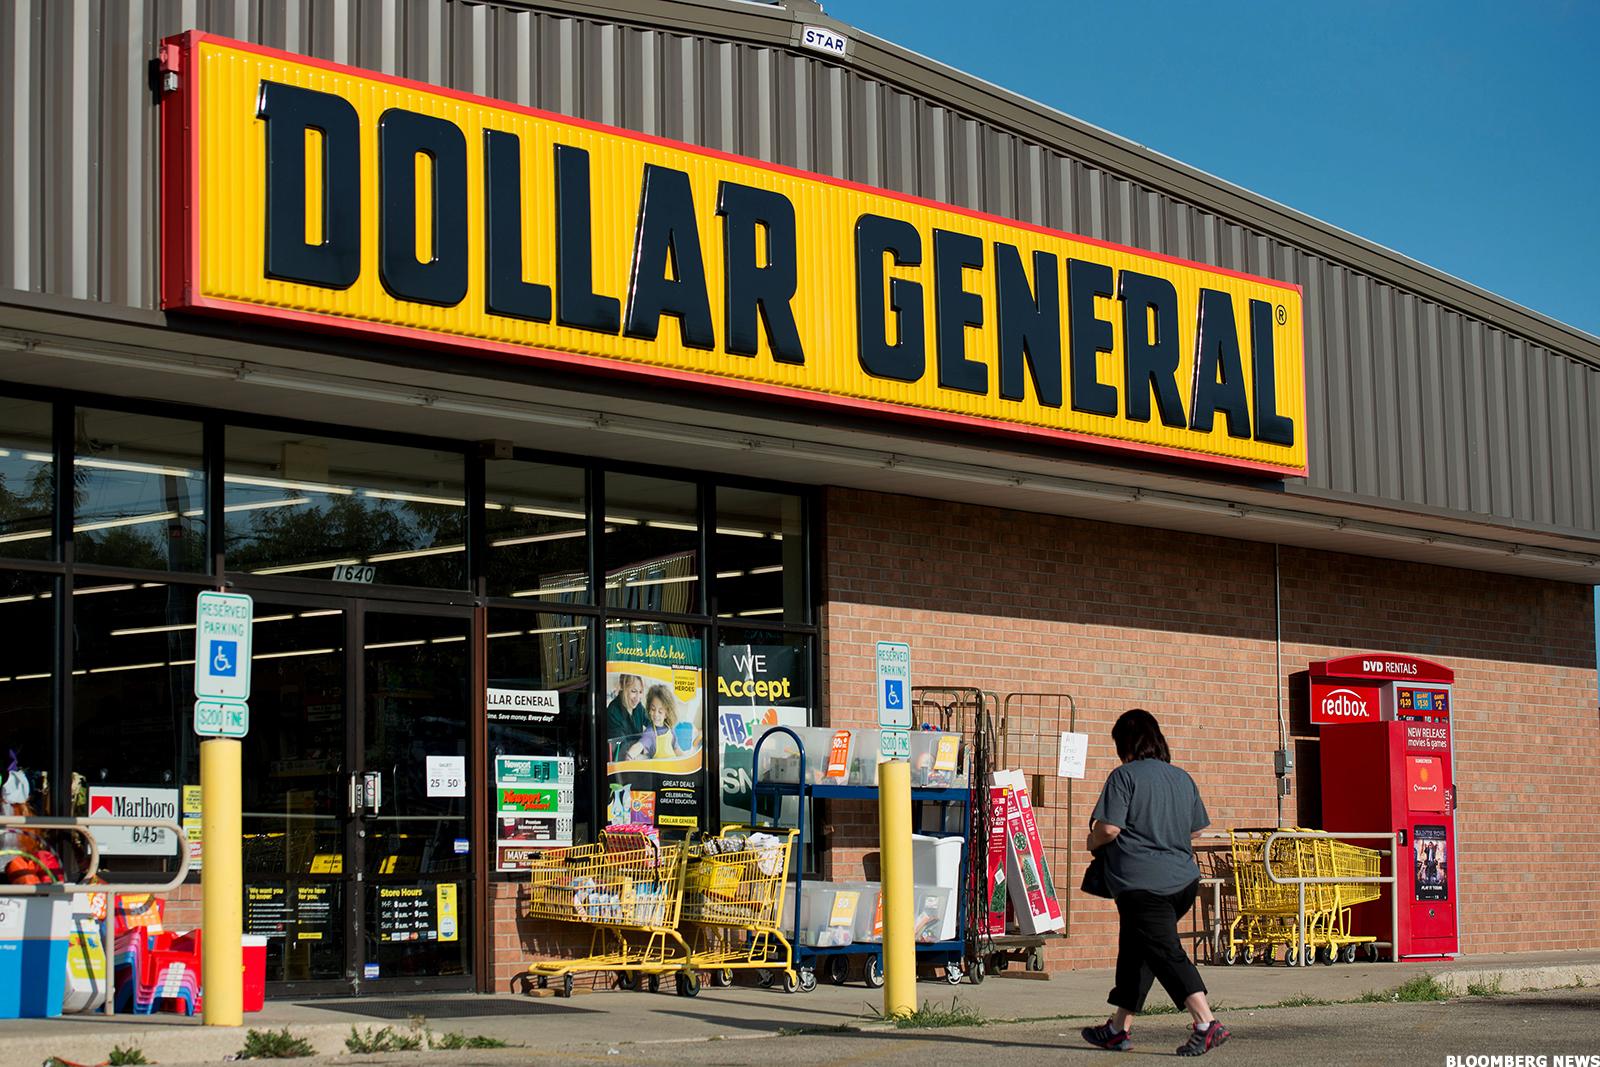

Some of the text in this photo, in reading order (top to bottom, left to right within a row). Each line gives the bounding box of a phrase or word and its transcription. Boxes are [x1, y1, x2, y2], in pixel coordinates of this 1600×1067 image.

[806, 30, 844, 51] STAR
[255, 79, 1295, 447] DOLLAR GENERAL
[336, 566, 373, 582] 1640
[201, 602, 247, 619] RESERVED
[204, 621, 244, 636] PARKING
[615, 641, 686, 659] Success starts here
[878, 650, 908, 662] RESERVED
[733, 655, 767, 673] WE
[881, 665, 907, 676] PARKING
[1363, 660, 1417, 674] DVD RENTALS
[717, 676, 791, 702] Accept
[487, 694, 555, 707] LLAR GENERAL
[200, 708, 243, 727] $200 FINE
[1407, 727, 1446, 739] NEW RELEASE
[881, 737, 908, 750] $200 FINE
[1407, 738, 1425, 747] movies
[1431, 740, 1447, 750] games
[504, 760, 531, 768] Newport
[722, 768, 753, 794] SN
[503, 790, 541, 806] Newport
[114, 796, 175, 818] Marlboro
[133, 826, 158, 843] 6.45
[380, 888, 422, 897] Store Hours
